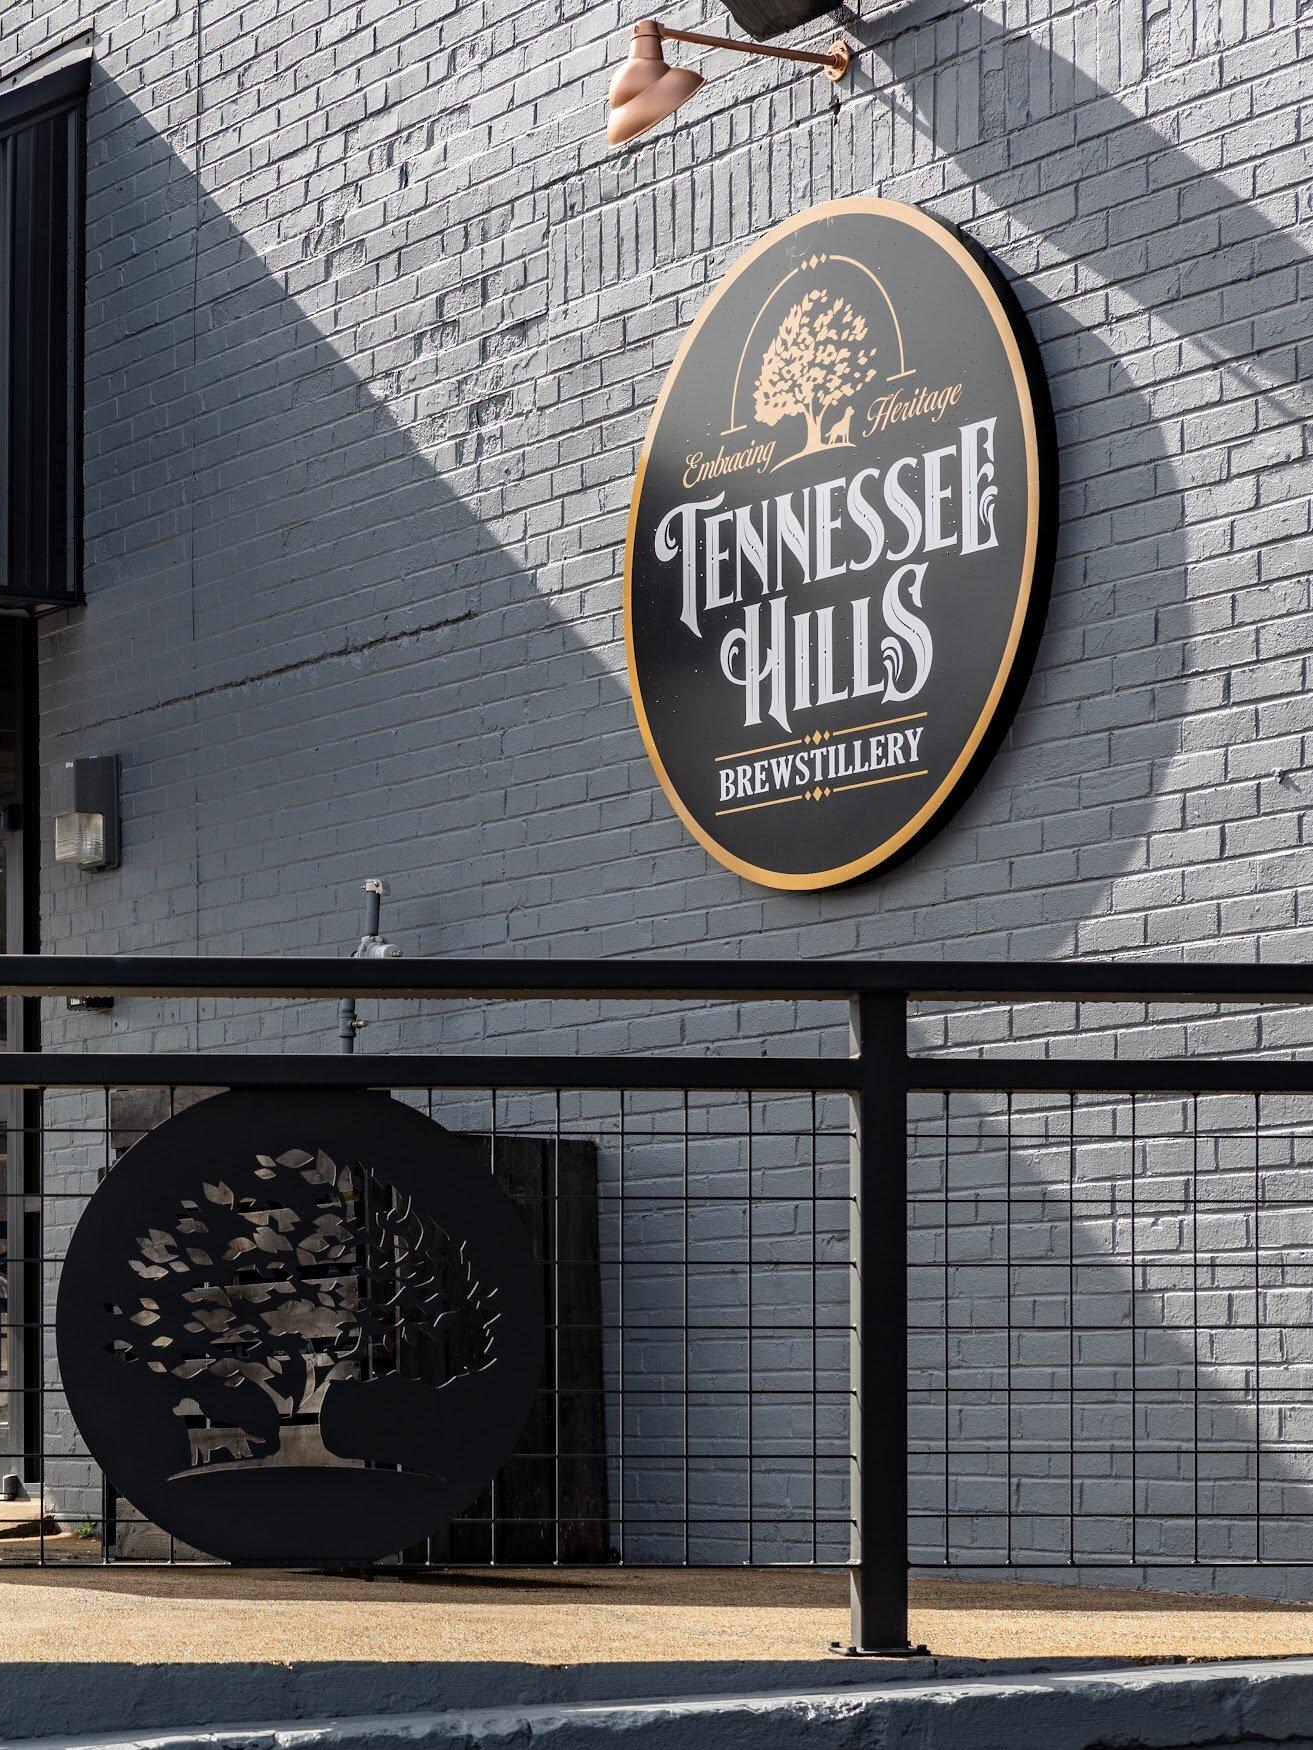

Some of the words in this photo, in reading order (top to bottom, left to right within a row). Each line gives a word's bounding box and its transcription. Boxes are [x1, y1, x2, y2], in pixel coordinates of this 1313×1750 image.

[682, 439, 776, 489] Embracing
[862, 383, 963, 437] Heritage
[654, 417, 999, 638] TENNESSEE
[720, 562, 934, 734] HILLS
[719, 727, 924, 801] BREWSTILLERY
